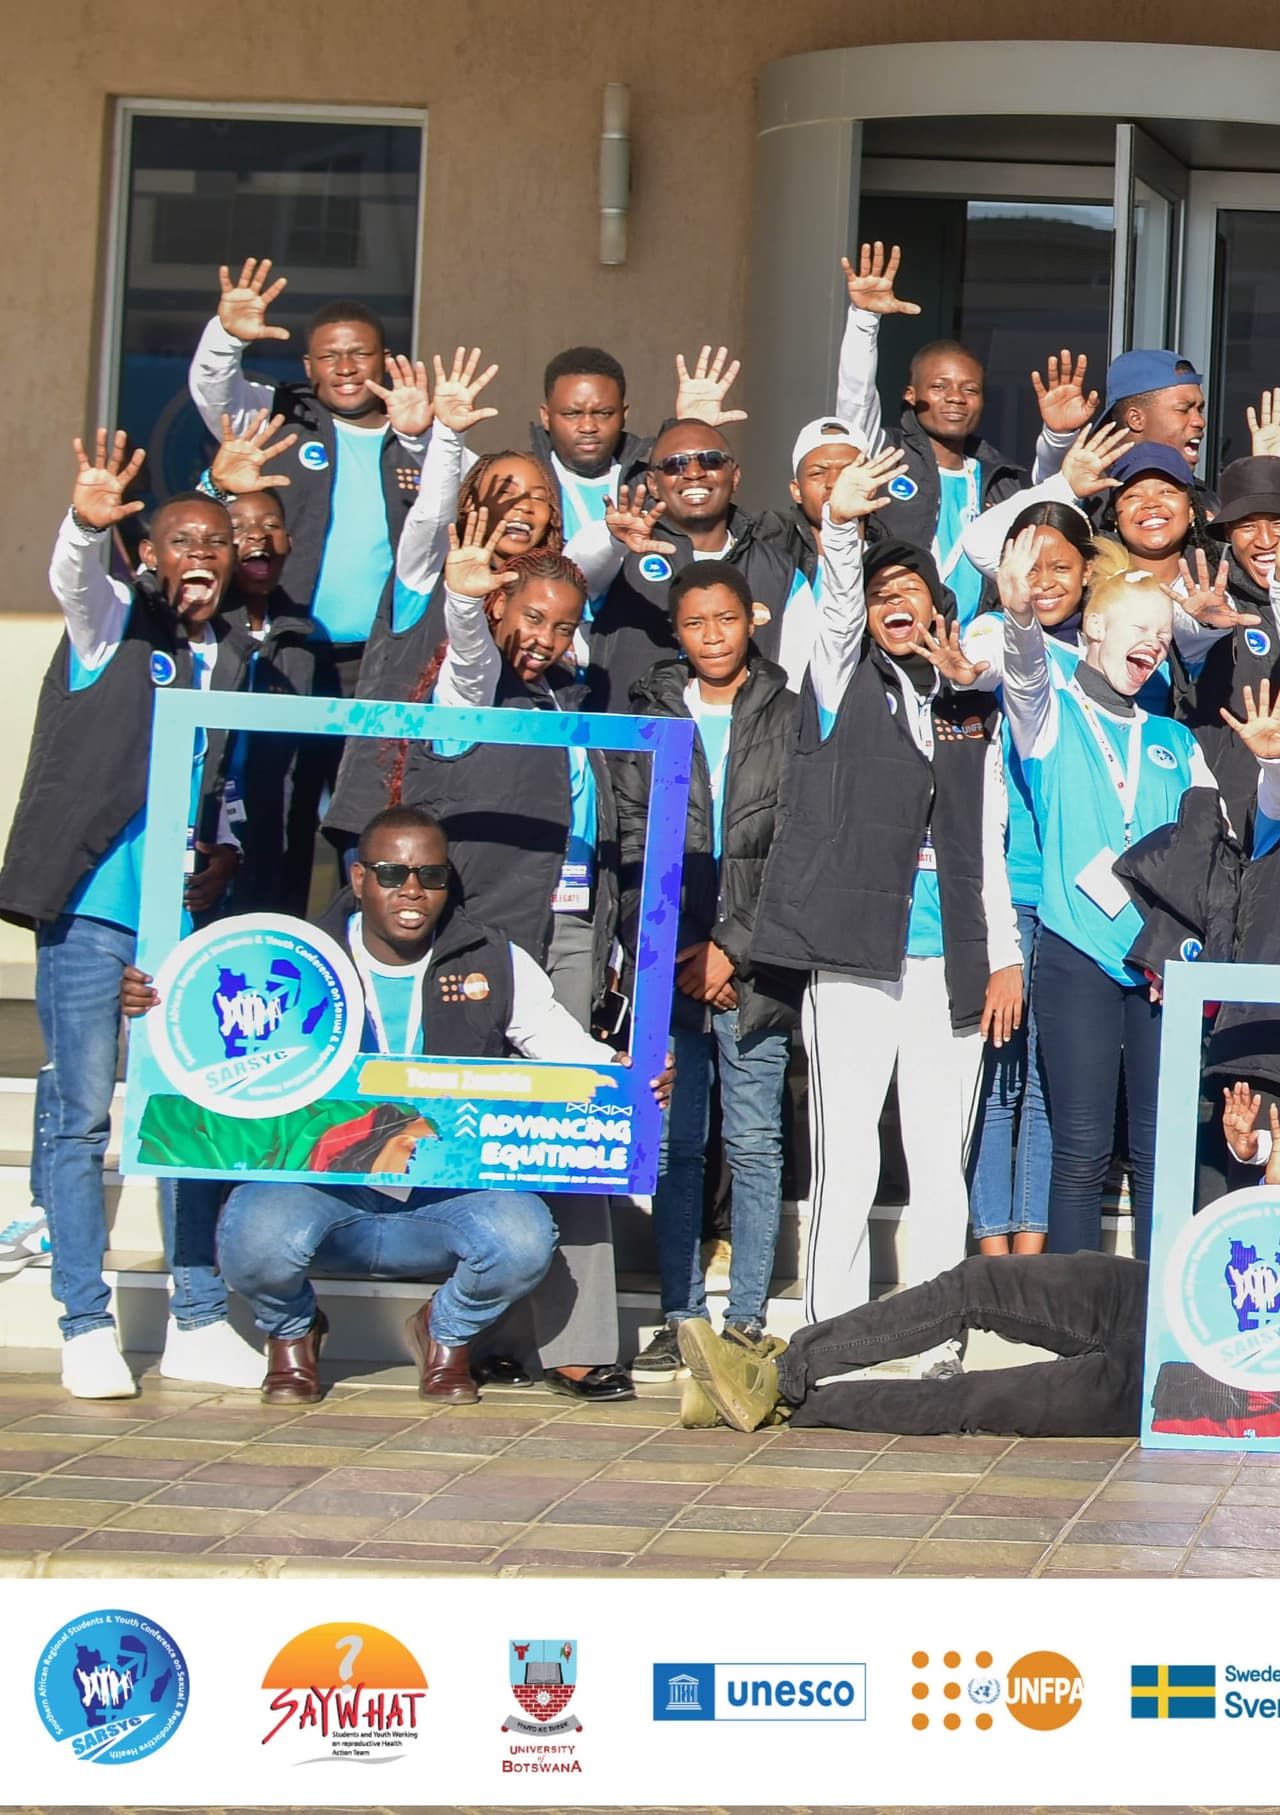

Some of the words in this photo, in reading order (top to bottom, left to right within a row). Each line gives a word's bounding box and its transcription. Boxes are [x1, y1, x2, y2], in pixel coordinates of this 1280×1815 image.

[961, 722, 983, 735] UNFP
[295, 945, 336, 986] Conference
[330, 988, 341, 1001] on
[204, 1050, 288, 1089] SARSYC
